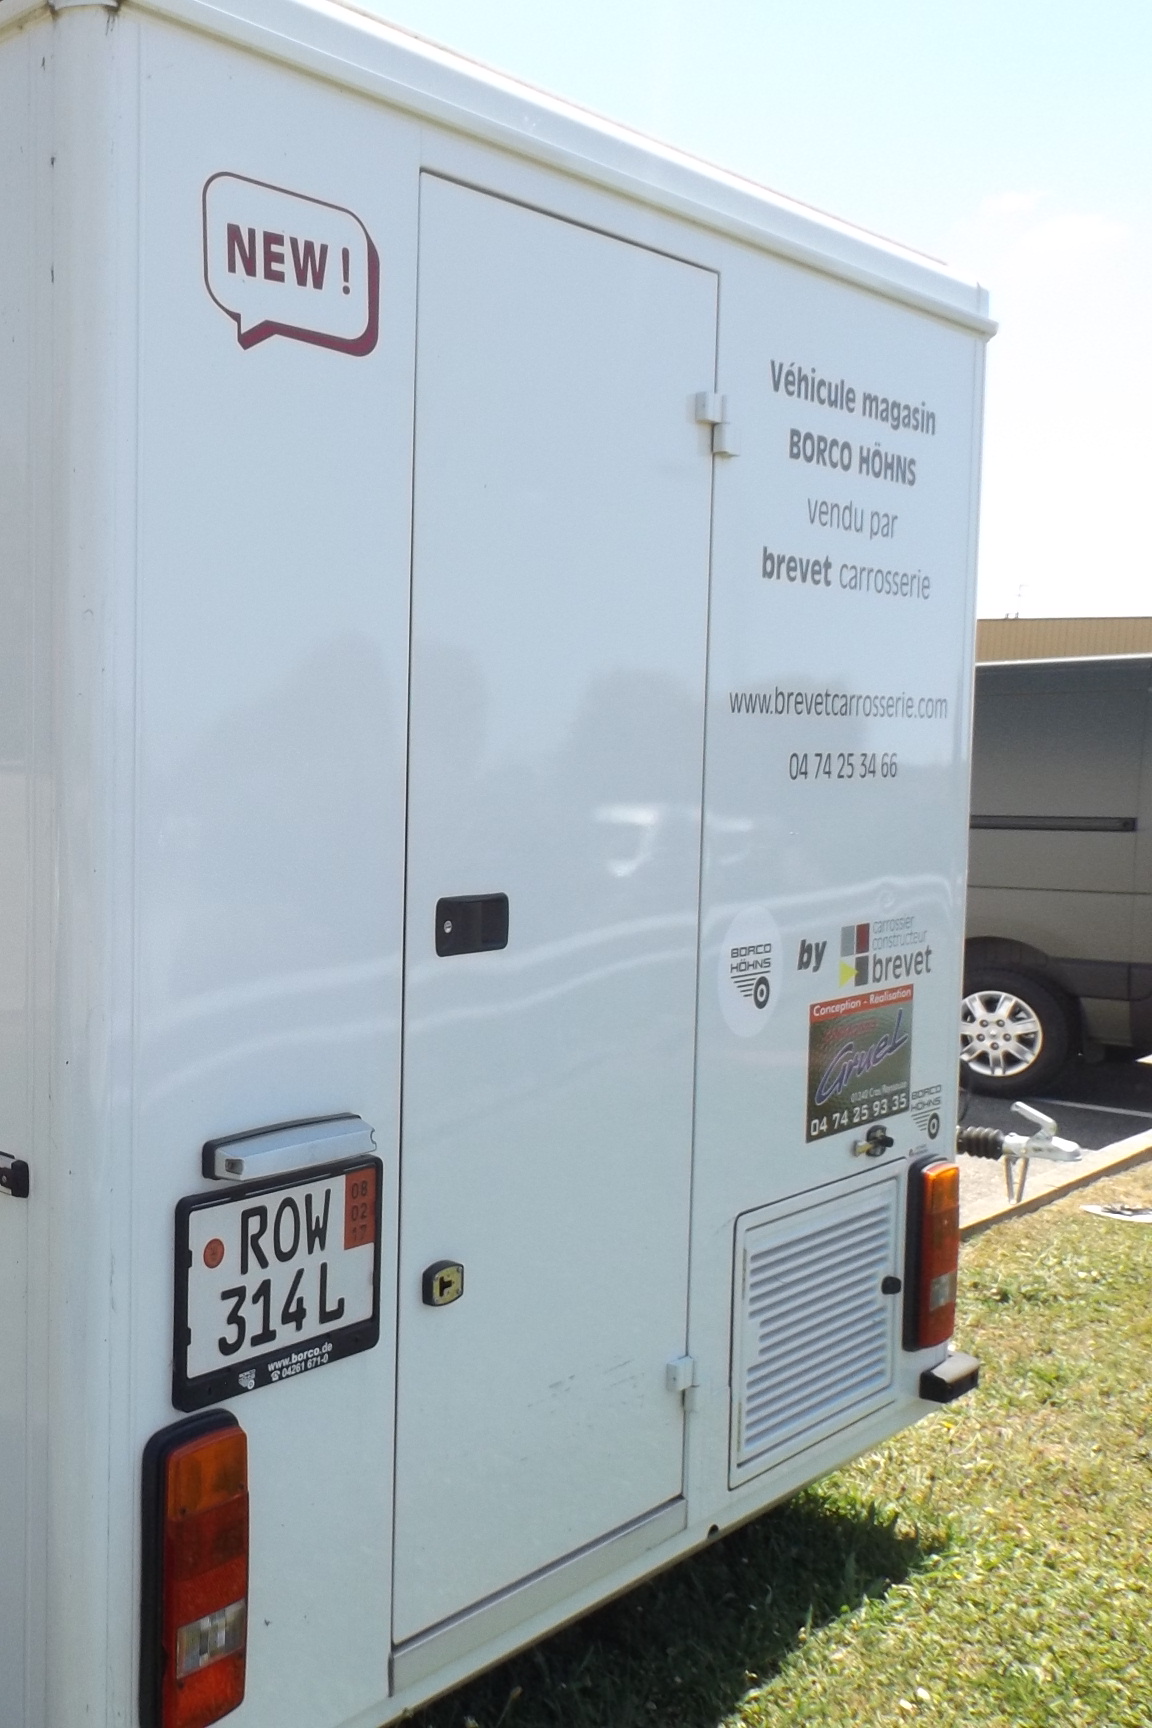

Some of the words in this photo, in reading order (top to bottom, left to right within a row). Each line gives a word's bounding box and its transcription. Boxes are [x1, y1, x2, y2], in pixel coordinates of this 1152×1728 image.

[226, 222, 329, 290] NEW
[770, 359, 856, 413] Véhicule
[862, 391, 936, 436] magasin
[788, 428, 852, 471] BORCO
[858, 442, 917, 487] HÖHNS
[807, 498, 864, 534] vendu
[869, 511, 899, 540] par
[762, 546, 832, 587] brevet
[839, 562, 931, 600] carrosserie
[729, 686, 948, 720] www.brevetcarrosserie.com
[789, 752, 808, 780] 04
[814, 752, 833, 779] 74
[837, 754, 855, 779] 25
[859, 754, 876, 778] 34
[881, 753, 897, 778] 66
[731, 943, 772, 958] BORCO
[797, 939, 827, 972] by
[872, 945, 932, 984] brevet
[813, 999, 861, 1017] Conception
[911, 1084, 942, 1101] BORCO
[810, 1120, 827, 1136] 04
[833, 1109, 848, 1129] 74
[853, 1104, 869, 1124] 25
[873, 1098, 888, 1117] 93
[892, 1092, 907, 1112] 35
[351, 1180, 368, 1199] 08
[351, 1202, 368, 1221] 02
[240, 1188, 331, 1275] ROW
[268, 1341, 333, 1372] www.borco.de
[281, 1360, 305, 1378] 04261
